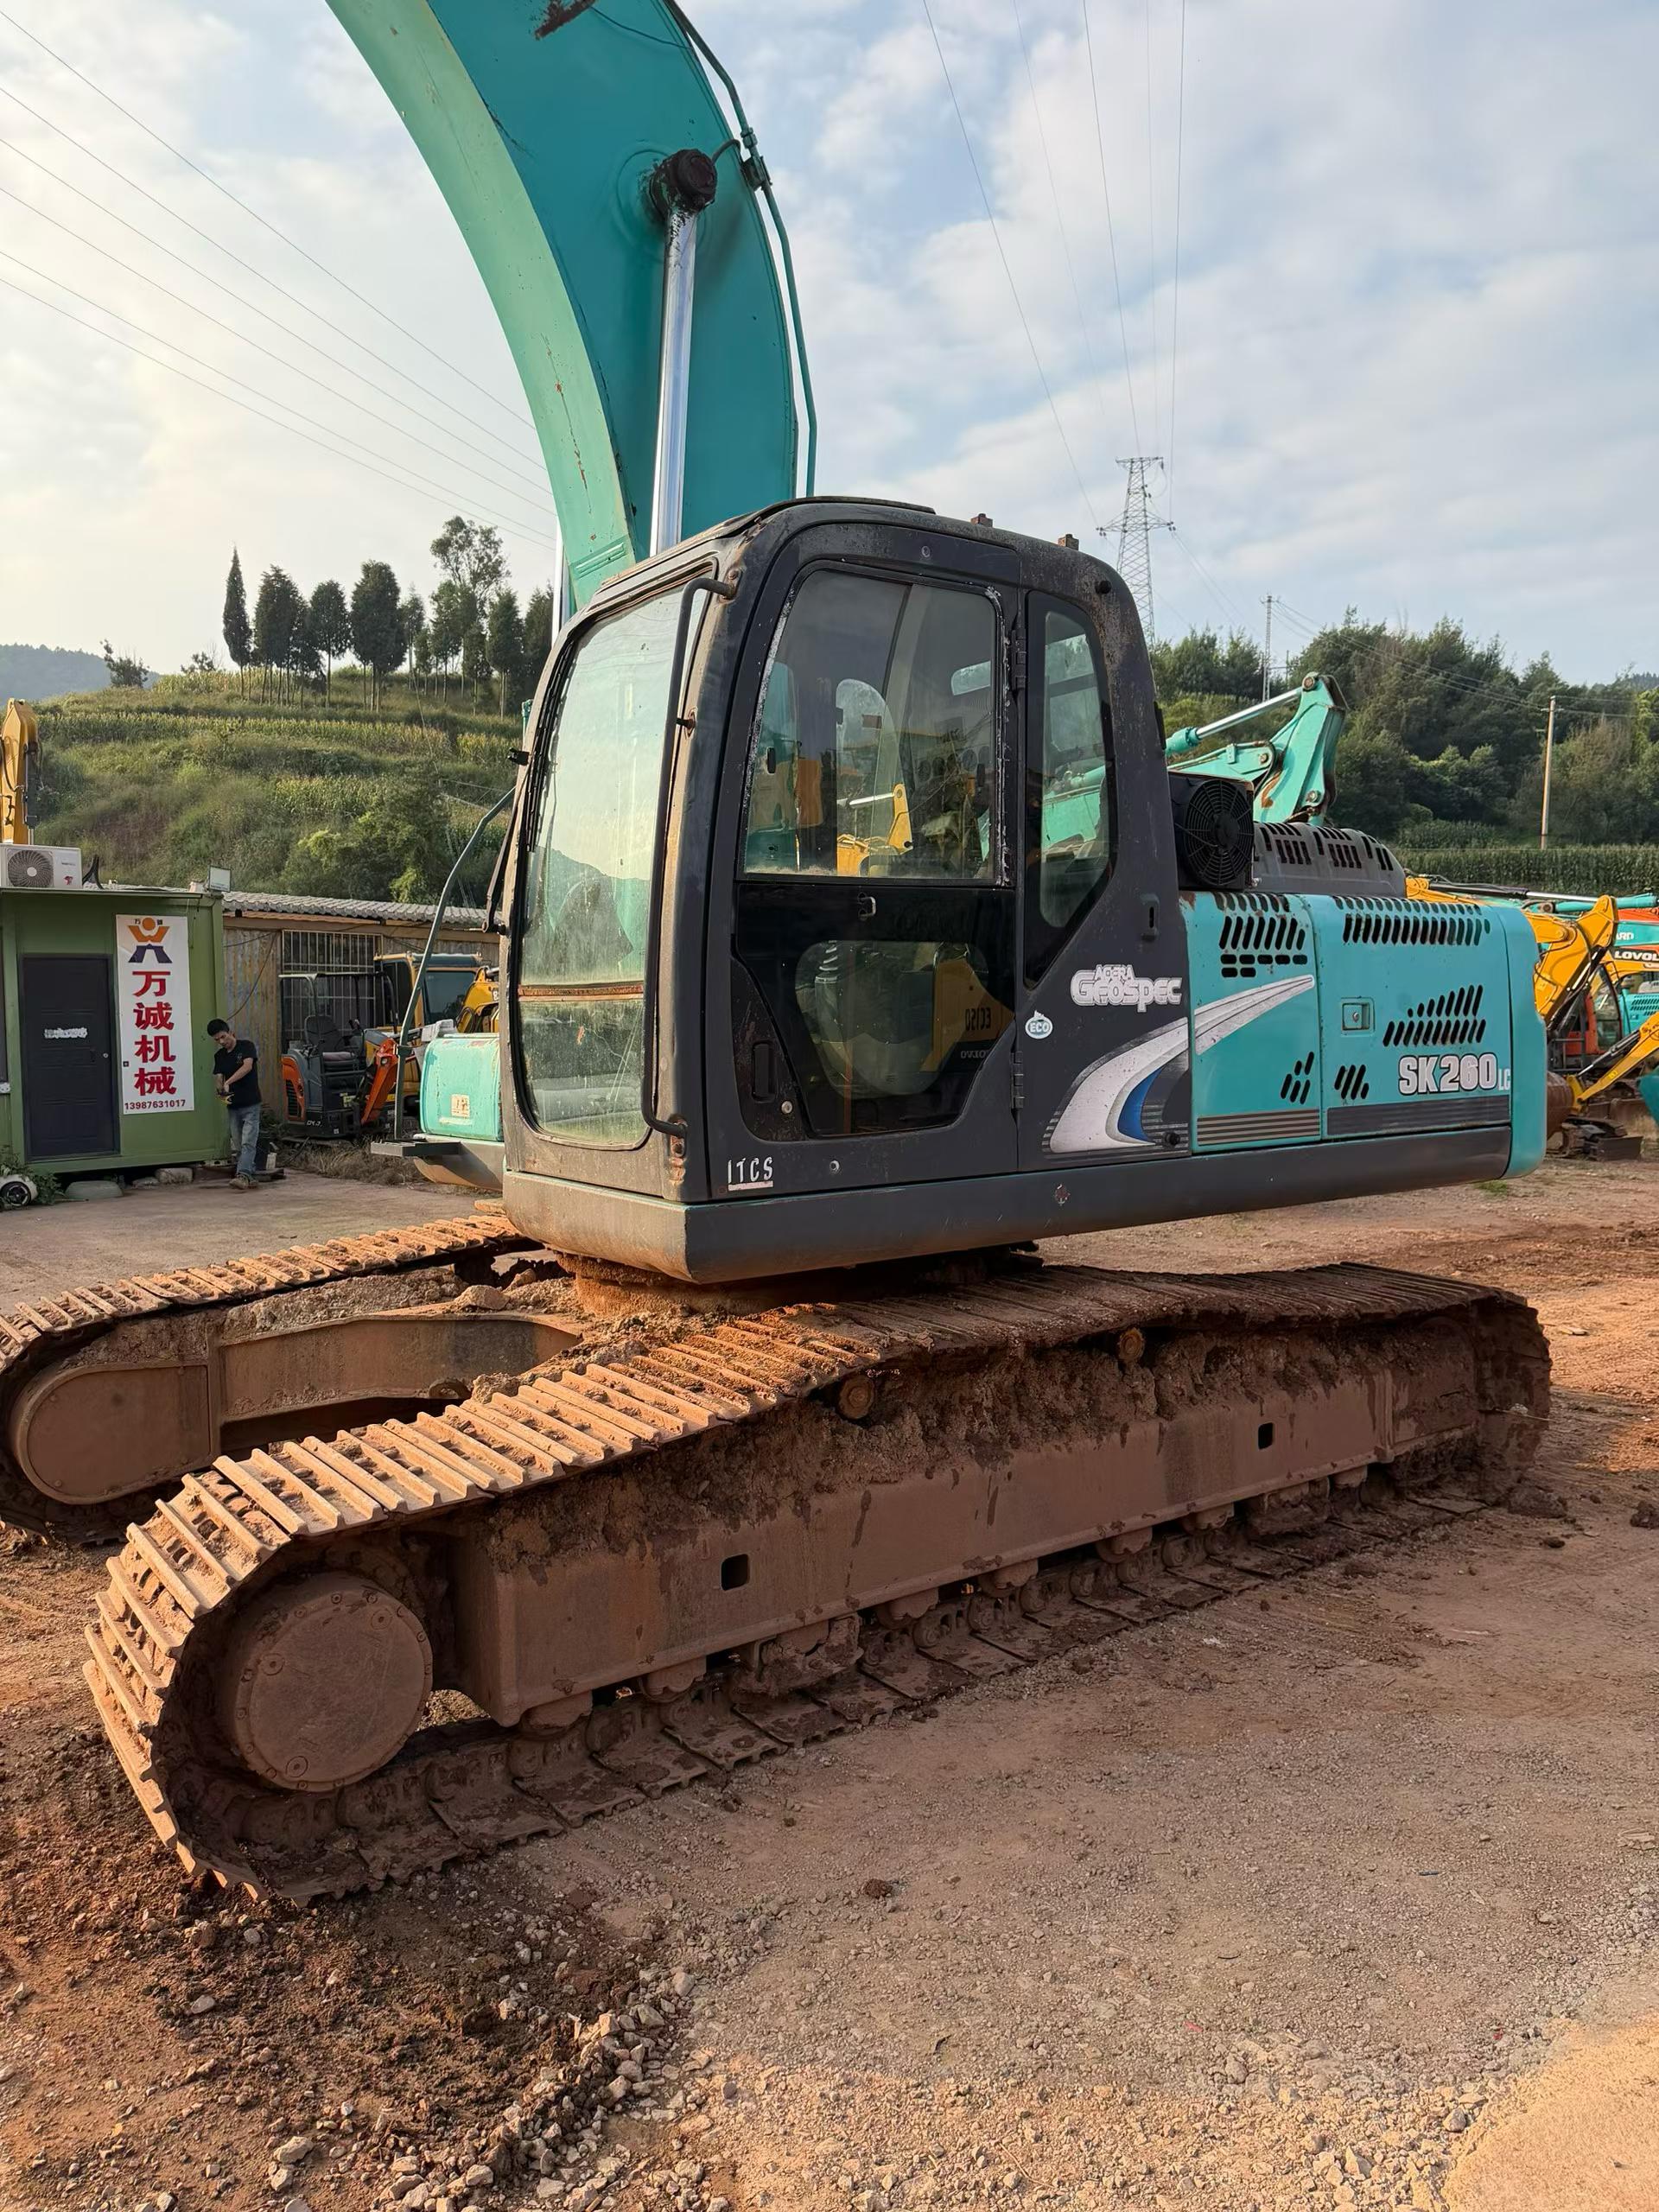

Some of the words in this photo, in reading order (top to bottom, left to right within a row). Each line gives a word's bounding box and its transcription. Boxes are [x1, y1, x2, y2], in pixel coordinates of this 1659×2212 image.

[132, 970, 176, 1096] 万诚机械
[1029, 1021, 1049, 1033] ECO
[1398, 1052, 1498, 1096] SK260
[124, 1099, 186, 1110] 13987631017
